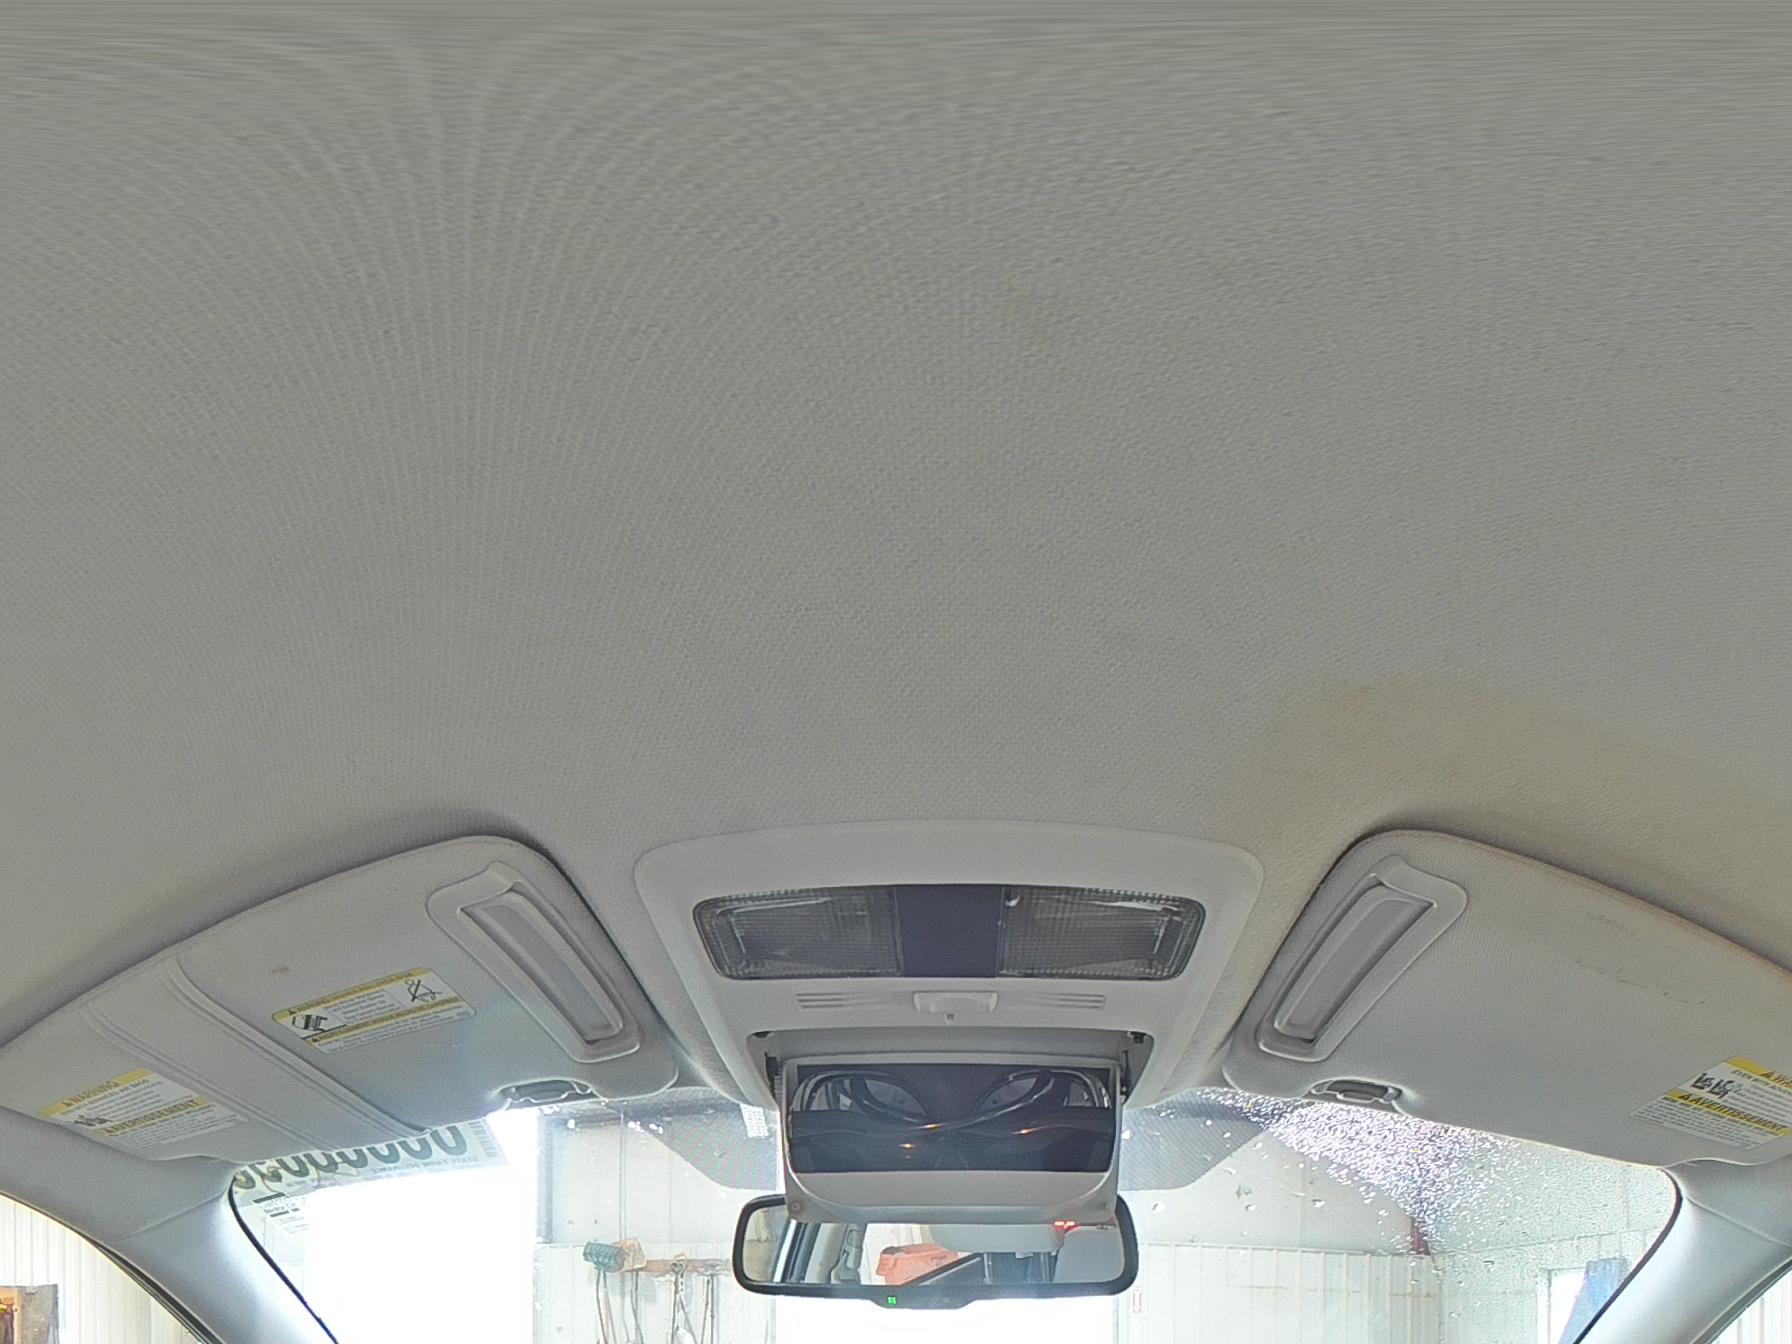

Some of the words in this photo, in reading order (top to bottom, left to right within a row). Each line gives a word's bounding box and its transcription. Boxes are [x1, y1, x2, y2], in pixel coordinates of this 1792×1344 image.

[68, 1080, 119, 1103] WARNING
[111, 1099, 199, 1131] AVERTISSEMENT
[1687, 1096, 1787, 1131] AVERTISSEMENT
